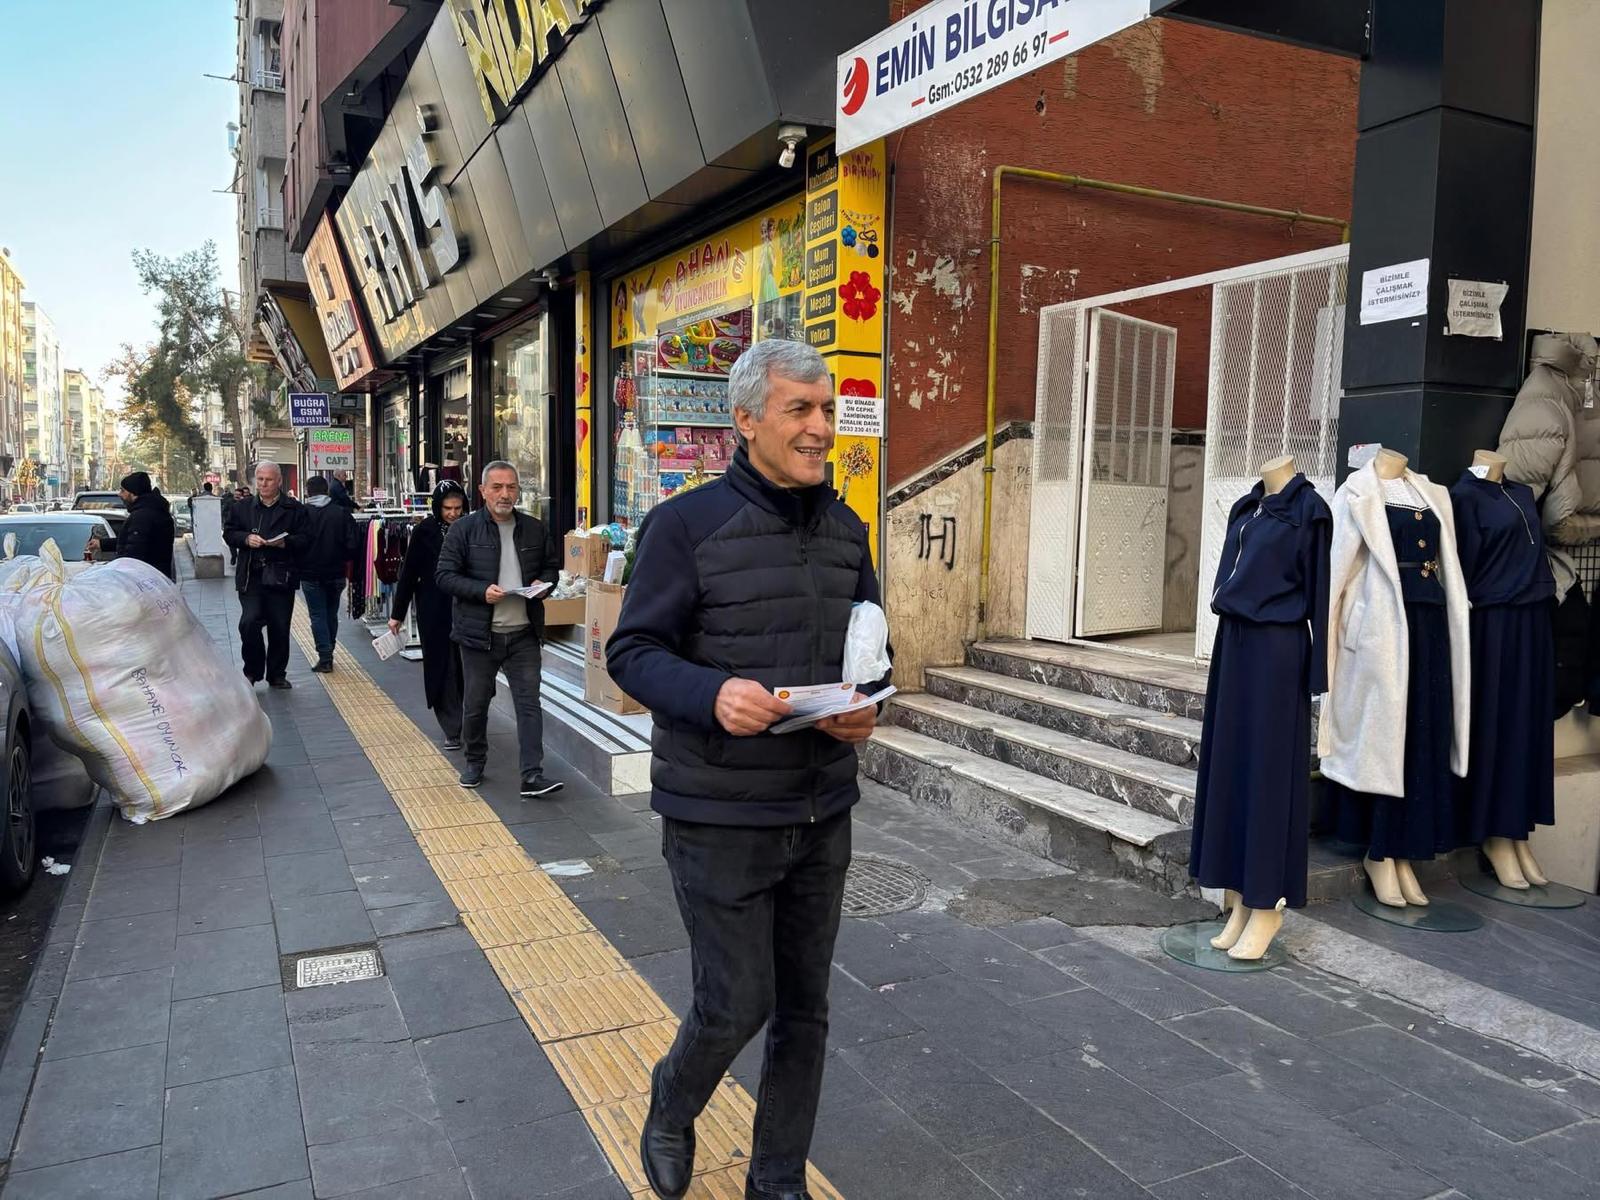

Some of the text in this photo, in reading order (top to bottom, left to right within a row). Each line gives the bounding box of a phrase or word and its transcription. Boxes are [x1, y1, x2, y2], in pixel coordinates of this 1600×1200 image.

[876, 22, 936, 96] EMİN
[928, 30, 1048, 104] Gsm:0532 289 66 97
[814, 198, 831, 216] Balon
[809, 211, 835, 239] Çeşitleri
[813, 247, 829, 264] Mum
[809, 260, 834, 287] Çeşitleri
[1380, 271, 1410, 284] BİZİMLE
[1375, 282, 1414, 296] ÇALIŞMAK
[810, 294, 831, 313] Meşale
[810, 327, 830, 344] Volkan
[293, 397, 325, 408] BUĞRA
[300, 408, 322, 416] GSM
[326, 456, 348, 465] CAFE
[130, 667, 189, 780] BAHANE OYUNCAK
